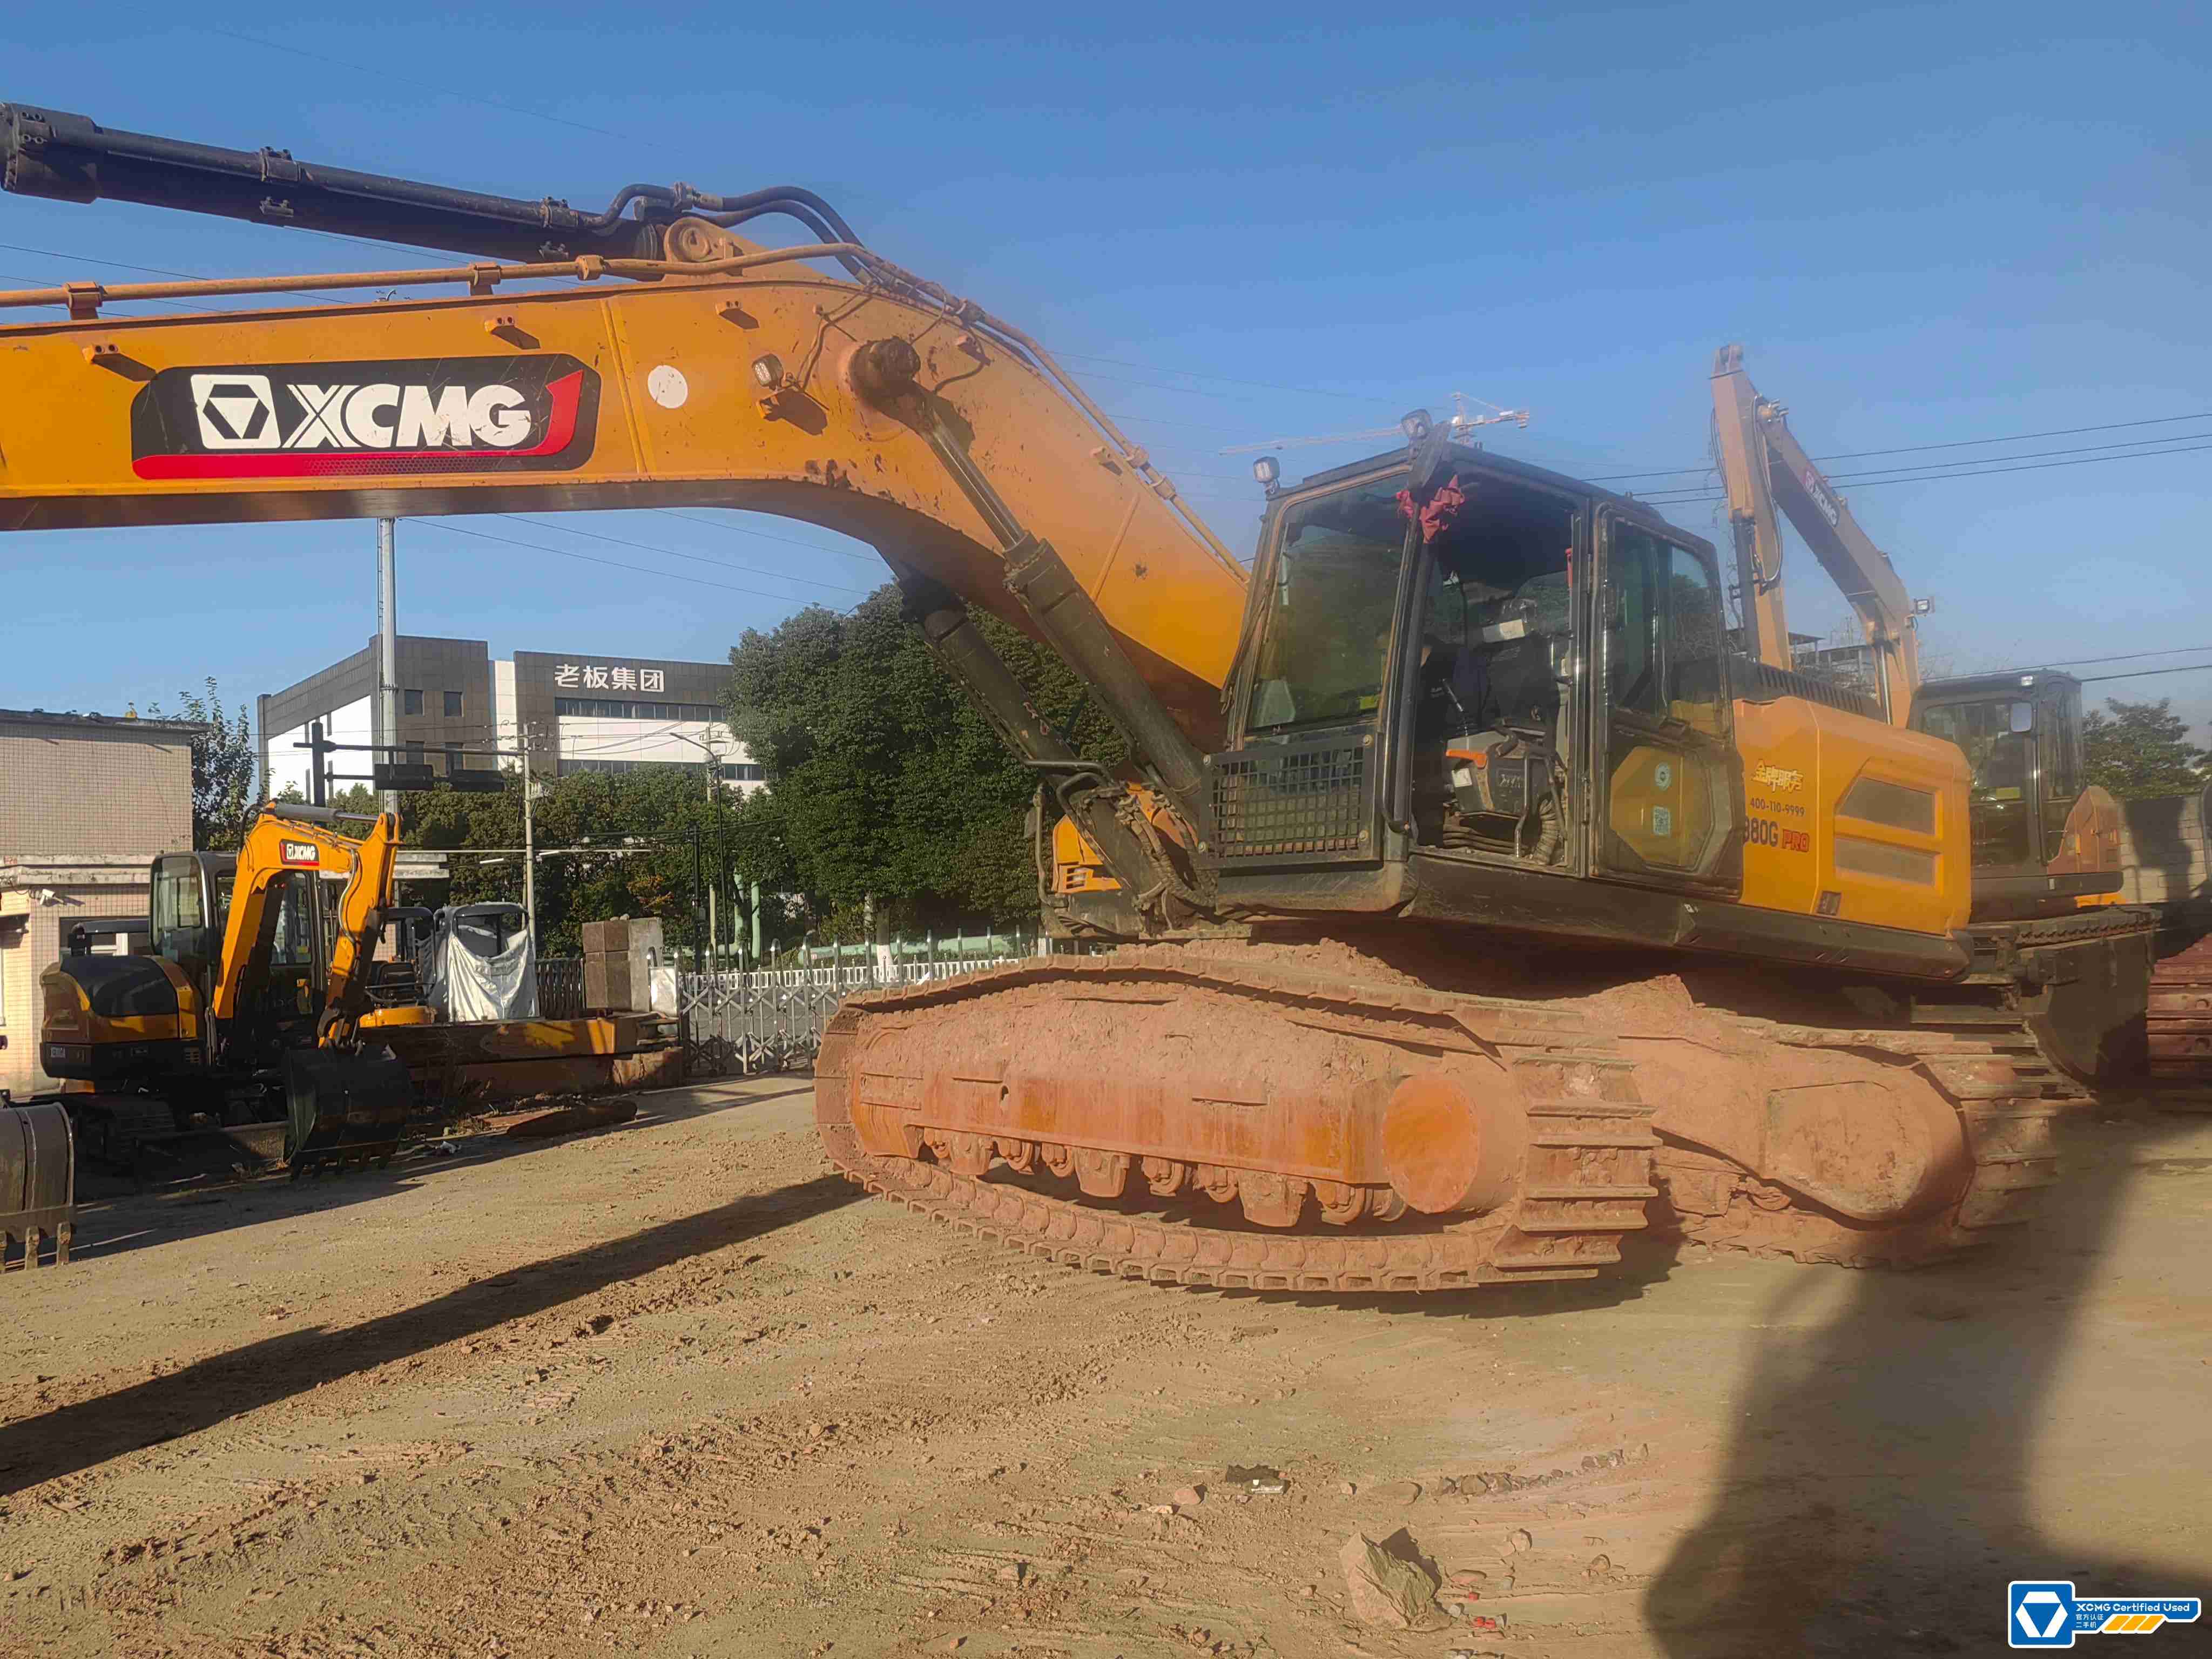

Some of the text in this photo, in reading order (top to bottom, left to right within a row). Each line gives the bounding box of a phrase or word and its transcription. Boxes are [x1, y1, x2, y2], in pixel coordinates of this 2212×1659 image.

[282, 383, 531, 448] XCMG
[554, 664, 664, 692] 老板集团
[293, 846, 316, 860] XCMG
[1782, 829, 1810, 853] PRO
